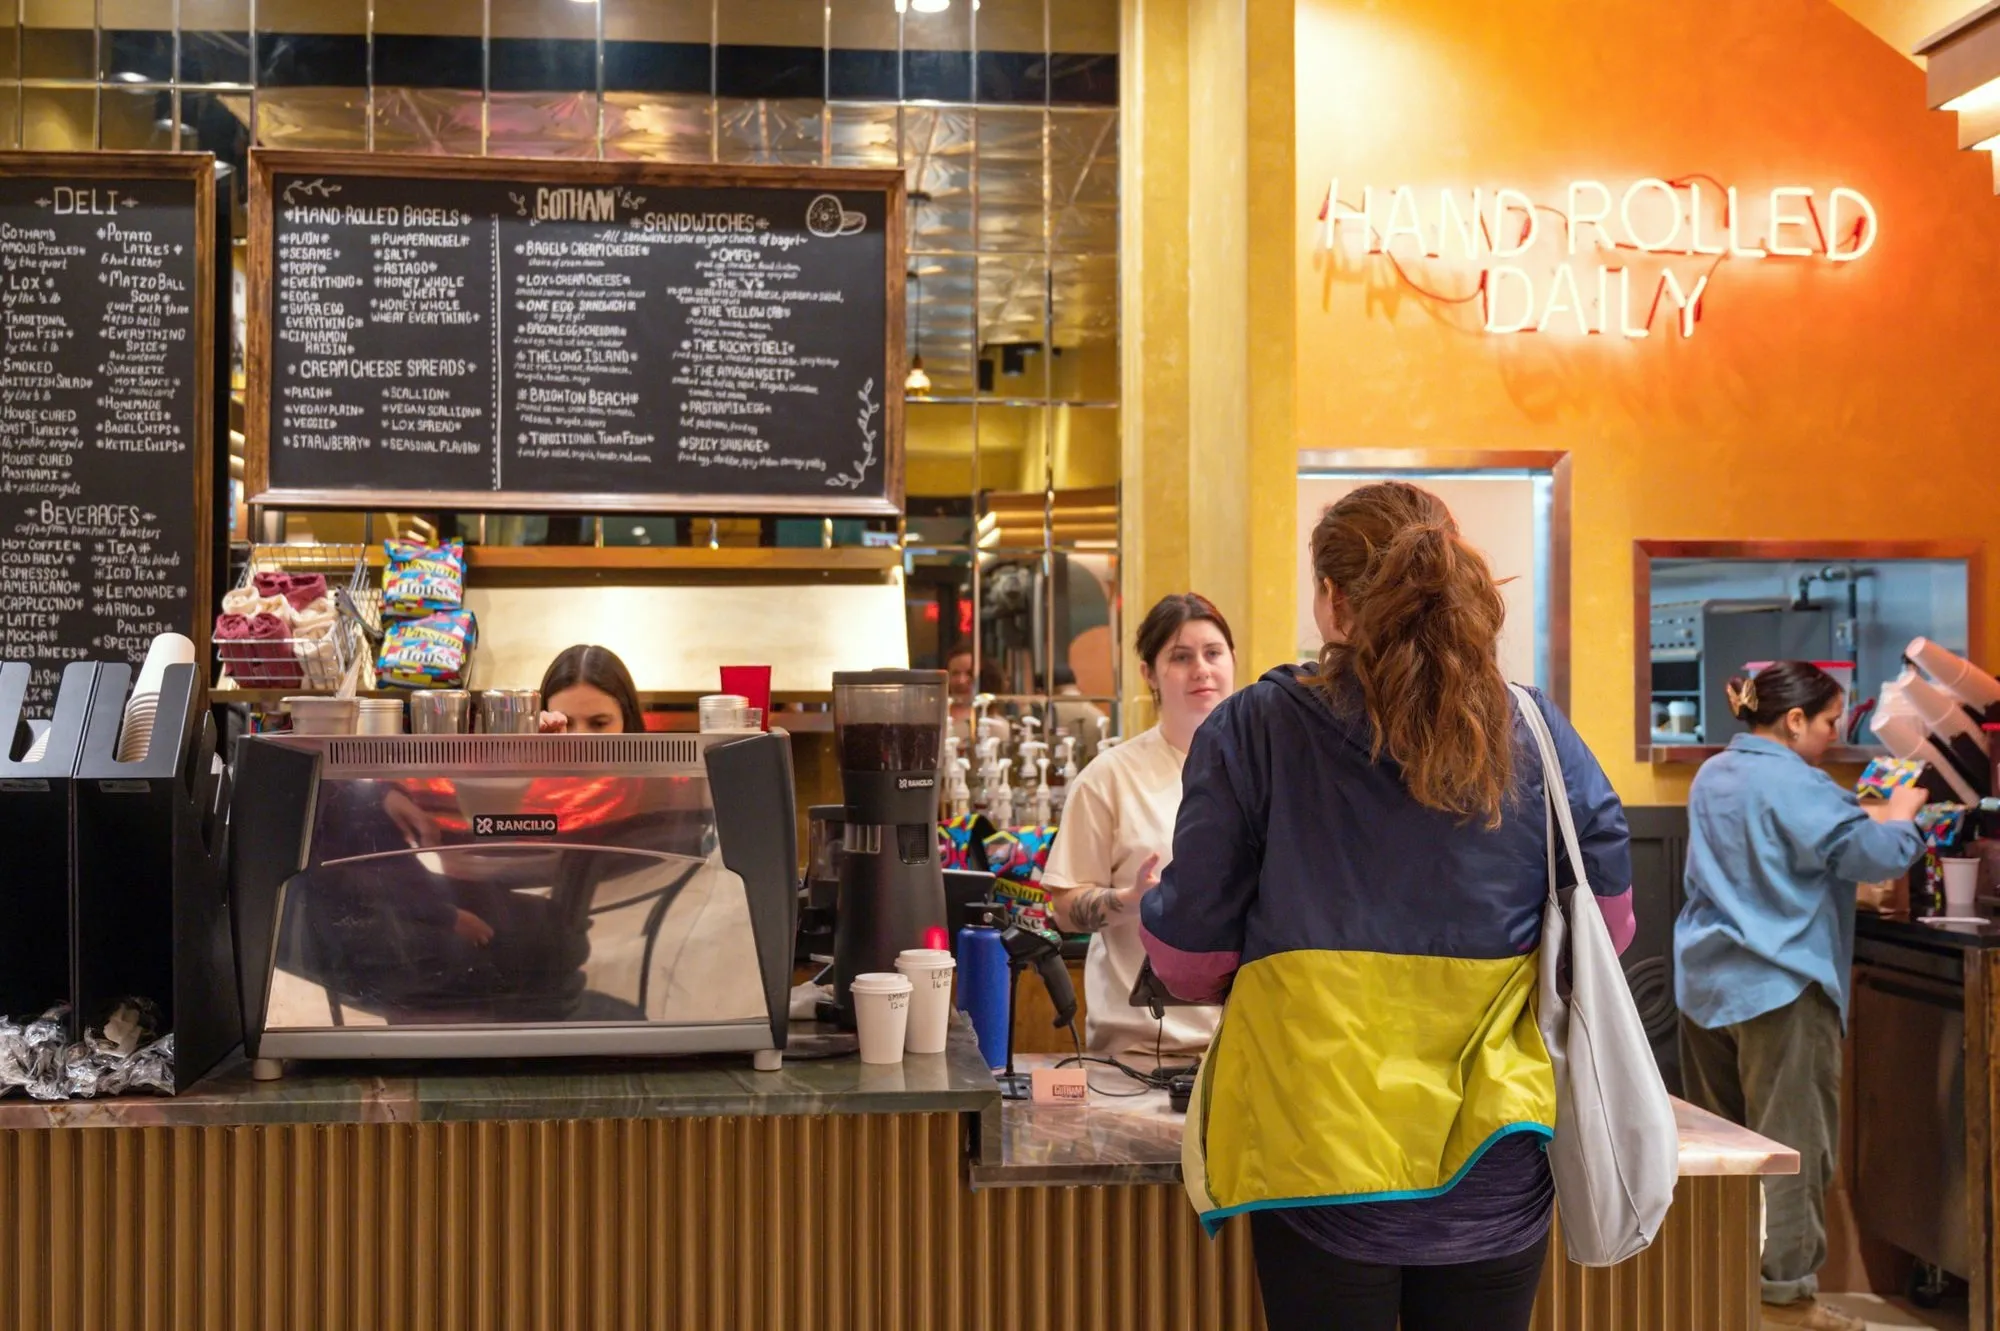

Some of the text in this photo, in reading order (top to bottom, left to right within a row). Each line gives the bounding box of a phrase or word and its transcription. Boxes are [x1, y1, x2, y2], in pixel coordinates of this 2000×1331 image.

[53, 186, 118, 215] DELI
[536, 187, 615, 222] GOTHAM
[403, 204, 460, 228] BAGELS
[643, 212, 755, 233] SANDWICHES
[1326, 177, 1878, 262] HAND ROLLED
[107, 221, 153, 241] POTATO
[290, 231, 320, 246] PLAIN
[123, 240, 169, 255] LATKES
[382, 232, 460, 248] PUMPERNICKEL
[289, 247, 332, 260] SESAME
[383, 248, 409, 261] SALT
[525, 240, 641, 258] BAGEL CREAM CHEESE
[290, 262, 318, 275] POPPY
[383, 261, 429, 275] ASIAGO
[11, 273, 40, 291] LOX
[109, 269, 185, 290] MATZO BALL
[289, 275, 355, 289] EVERYTHING
[383, 275, 465, 290] HONEY WHOLE
[525, 273, 623, 287] LOX CREAM CHEESE
[717, 279, 737, 291] THE
[130, 288, 160, 303] SOUP
[402, 287, 446, 299] WHEAT
[1484, 262, 1708, 339] DAILY
[289, 302, 322, 315] SUPER
[379, 298, 460, 312] HONEY WHOLE
[526, 299, 626, 313] ONE EGG SANDWICH
[701, 305, 722, 318] THE
[725, 306, 765, 320] YELLOW
[286, 315, 355, 330] EVERYTHING
[371, 310, 473, 325] WHEAT EVERYTHING
[36, 325, 64, 340] FISH
[108, 326, 186, 341] EVERYTHING
[288, 329, 348, 343] CINNAMON
[126, 339, 158, 352] SPICE
[305, 341, 347, 356] RAISIN
[694, 339, 718, 354] THE
[761, 341, 788, 356] DELI
[527, 347, 630, 364] THE LONG ISLAND
[3, 357, 53, 374] SMOKED
[300, 358, 466, 379] CREAM CHEESE SPREADS
[692, 365, 789, 381] THE AMAGANSETT
[291, 385, 325, 399] PLAIN
[390, 386, 445, 400] SCALLION
[529, 386, 630, 407] BRIGHTON BEACH
[104, 394, 162, 410] HOMEMADE
[689, 400, 738, 415] PASTRAMI
[746, 402, 765, 415] EGG
[115, 410, 162, 421] COOKIES
[293, 403, 359, 417] VEGAN PLAIN
[390, 403, 477, 418] VEGAN SCALLION
[28, 420, 69, 436] TURKEY
[104, 419, 172, 436] BAGEL CHIPS
[293, 416, 332, 430] VEGGIE
[391, 418, 455, 433] LOX SPREAD
[104, 436, 178, 453] KETTLE CHIPS
[292, 434, 364, 451] STRAWBERRY
[389, 437, 439, 453] SEASONAL
[688, 437, 763, 453] SPICY SAUSAGE
[2, 464, 58, 480] PASTRAMI
[41, 499, 140, 526] BEVERAGES
[1, 538, 72, 551] HOT COFFEE
[106, 538, 137, 555] TEA
[1, 551, 64, 565] COLD BREW
[1, 565, 60, 579] ESPRESSO
[104, 564, 155, 581] ICED TEA
[3, 580, 72, 595] AMERICANO
[105, 583, 175, 599] LEMONADE
[2, 595, 76, 612] CAPPUCCINO
[104, 602, 156, 616] ARNOLD
[7, 612, 47, 627] LATTE
[116, 619, 163, 634] PALMER
[7, 629, 48, 643] MOCHA
[38, 644, 77, 659] KNEES
[496, 820, 556, 831] RANCILIO
